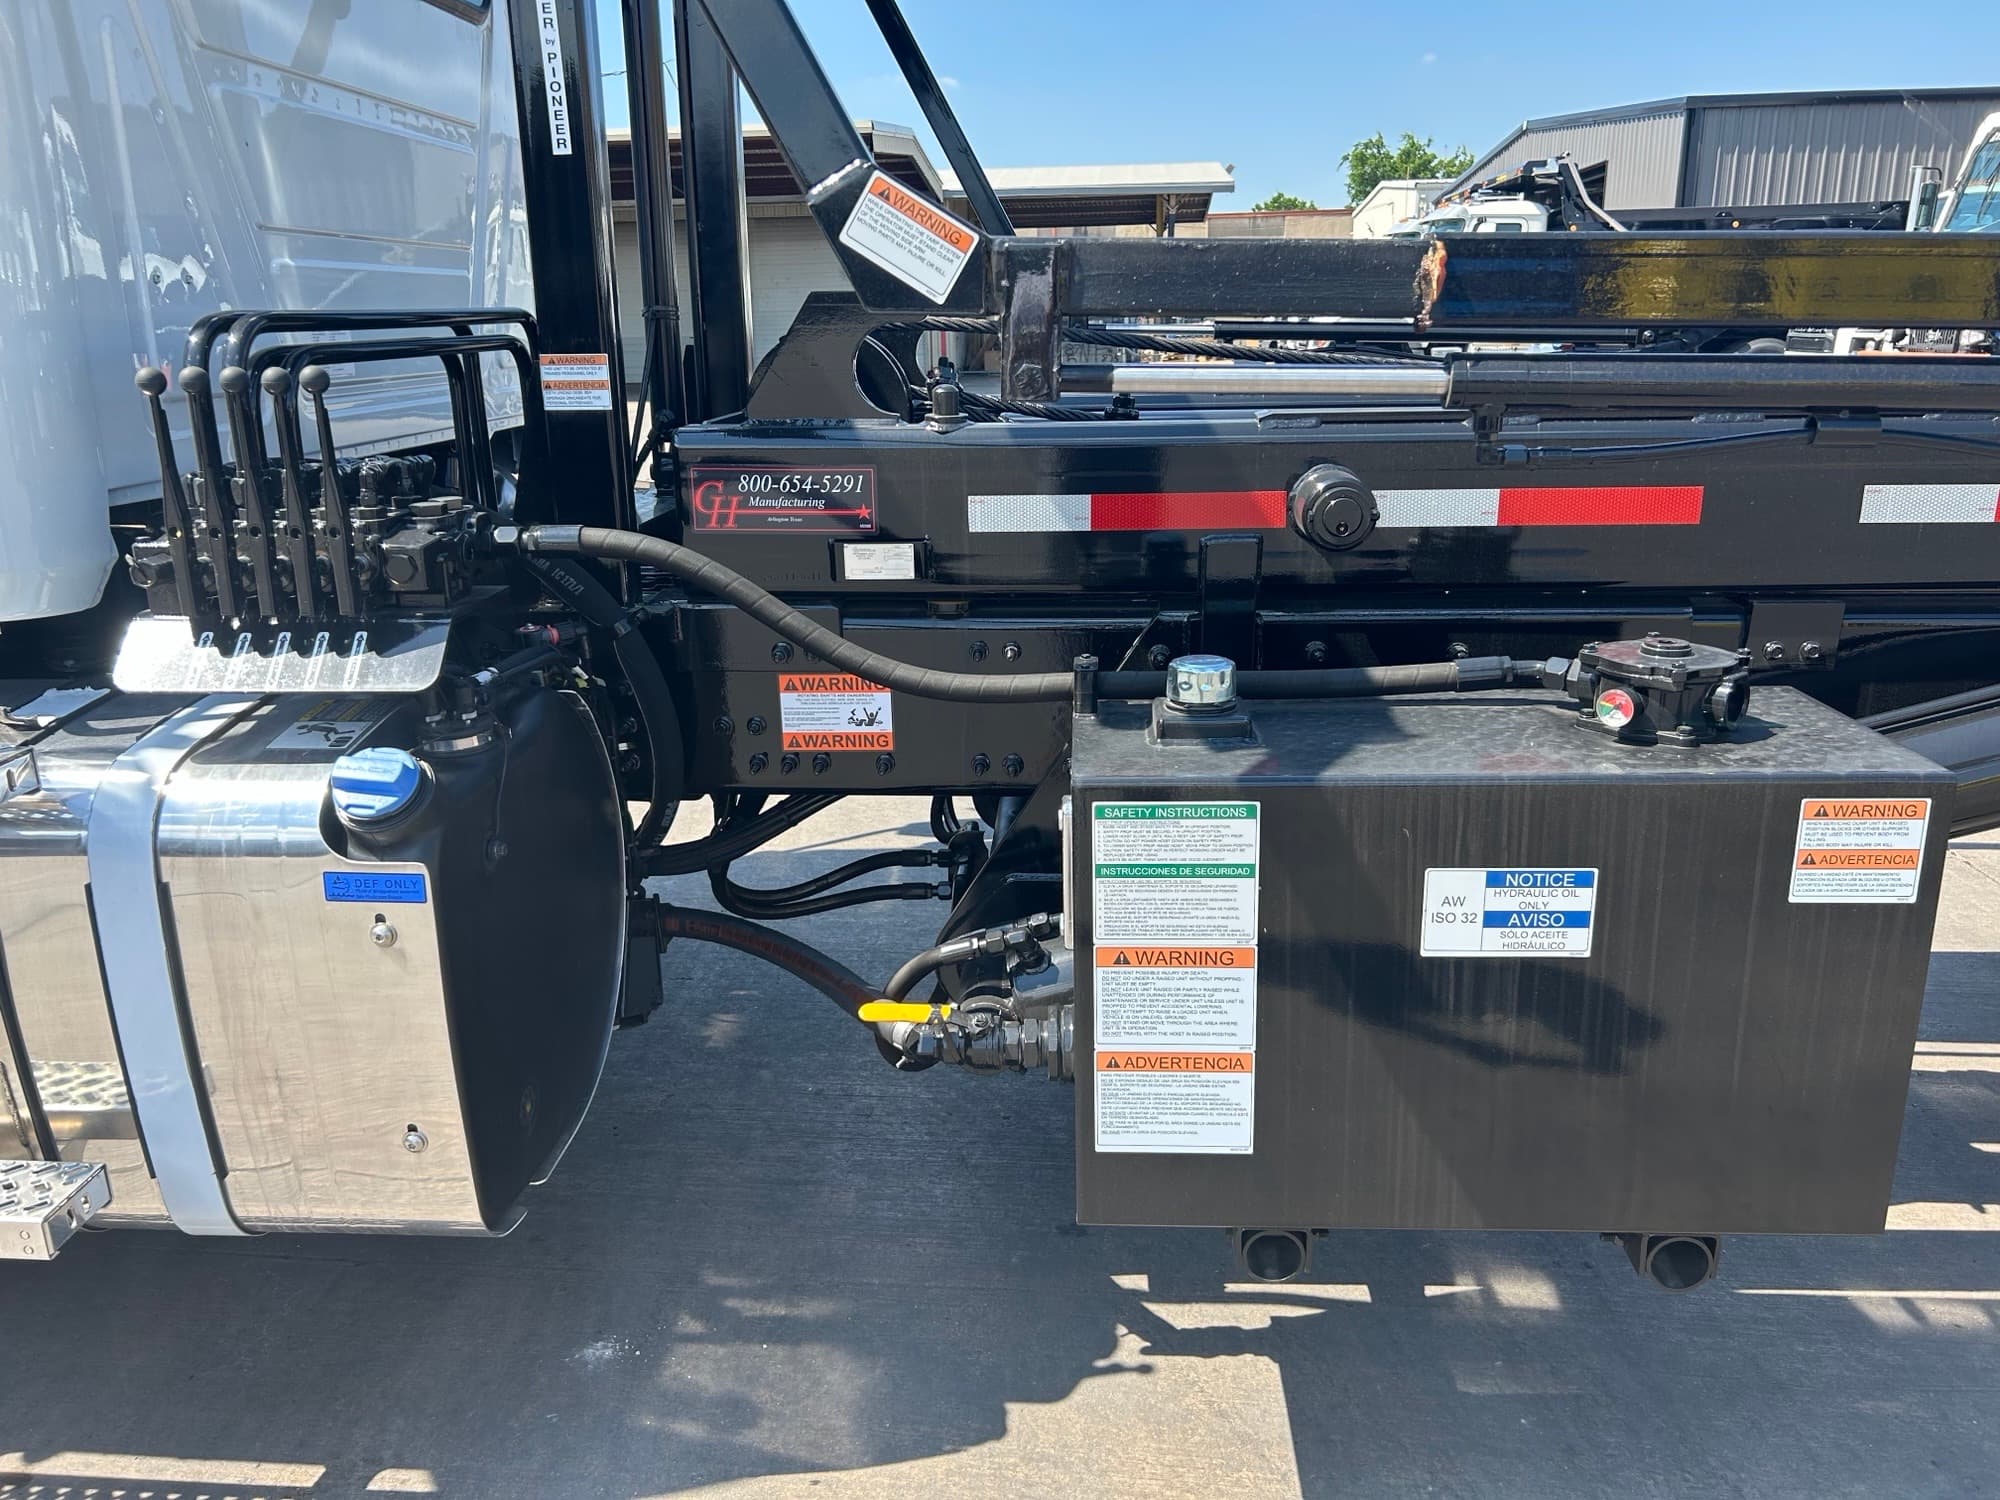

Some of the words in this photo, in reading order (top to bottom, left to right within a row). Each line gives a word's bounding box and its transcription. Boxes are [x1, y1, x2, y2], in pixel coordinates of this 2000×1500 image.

[545, 38, 555, 46] by
[547, 52, 567, 149] PIONEER
[859, 209, 868, 217] OF
[868, 215, 879, 224] THE
[878, 222, 900, 238] MOVING
[893, 193, 962, 245] WARNING
[863, 203, 874, 213] THE
[874, 210, 903, 232] OPERATOR
[903, 229, 918, 241] MUST
[918, 239, 936, 253] STAND
[883, 208, 914, 230] OPERATING
[914, 227, 924, 236] THE
[939, 243, 960, 259] SYSTEM
[856, 216, 877, 233] MOVING
[877, 229, 895, 243] PARTS
[894, 241, 907, 251] MAY
[906, 248, 925, 263] INJURE
[925, 260, 934, 269] OR
[738, 474, 864, 493] 800-654-5291
[748, 496, 825, 509] Manufacturing
[802, 734, 889, 747] WARNING
[1104, 807, 1152, 818] SAFETY
[1155, 807, 1247, 817] INSTRUCTIONS
[1819, 854, 1916, 865] ADVERTENCIA
[1100, 867, 1177, 876] INSTRUCCIONES
[1179, 867, 1193, 876] DE
[1194, 867, 1250, 876] SEGURIDAD
[354, 879, 379, 889] DEF
[384, 879, 419, 889] ONLY
[1505, 873, 1576, 887] NOTICE
[1494, 889, 1559, 898] HYDRAULIC
[1561, 889, 1580, 898] OIL
[1441, 896, 1466, 907] AW
[1518, 901, 1549, 910] ONLY
[1431, 912, 1457, 924] ISO
[1460, 912, 1478, 924] 32
[1507, 913, 1565, 926] AVISO
[1500, 930, 1529, 939] SÓLO
[1531, 930, 1568, 939] ACEITE
[1502, 941, 1566, 950] HIDRÁULICO
[1135, 951, 1234, 966] WARNING
[1123, 1056, 1245, 1070] ADVERTENCIA
